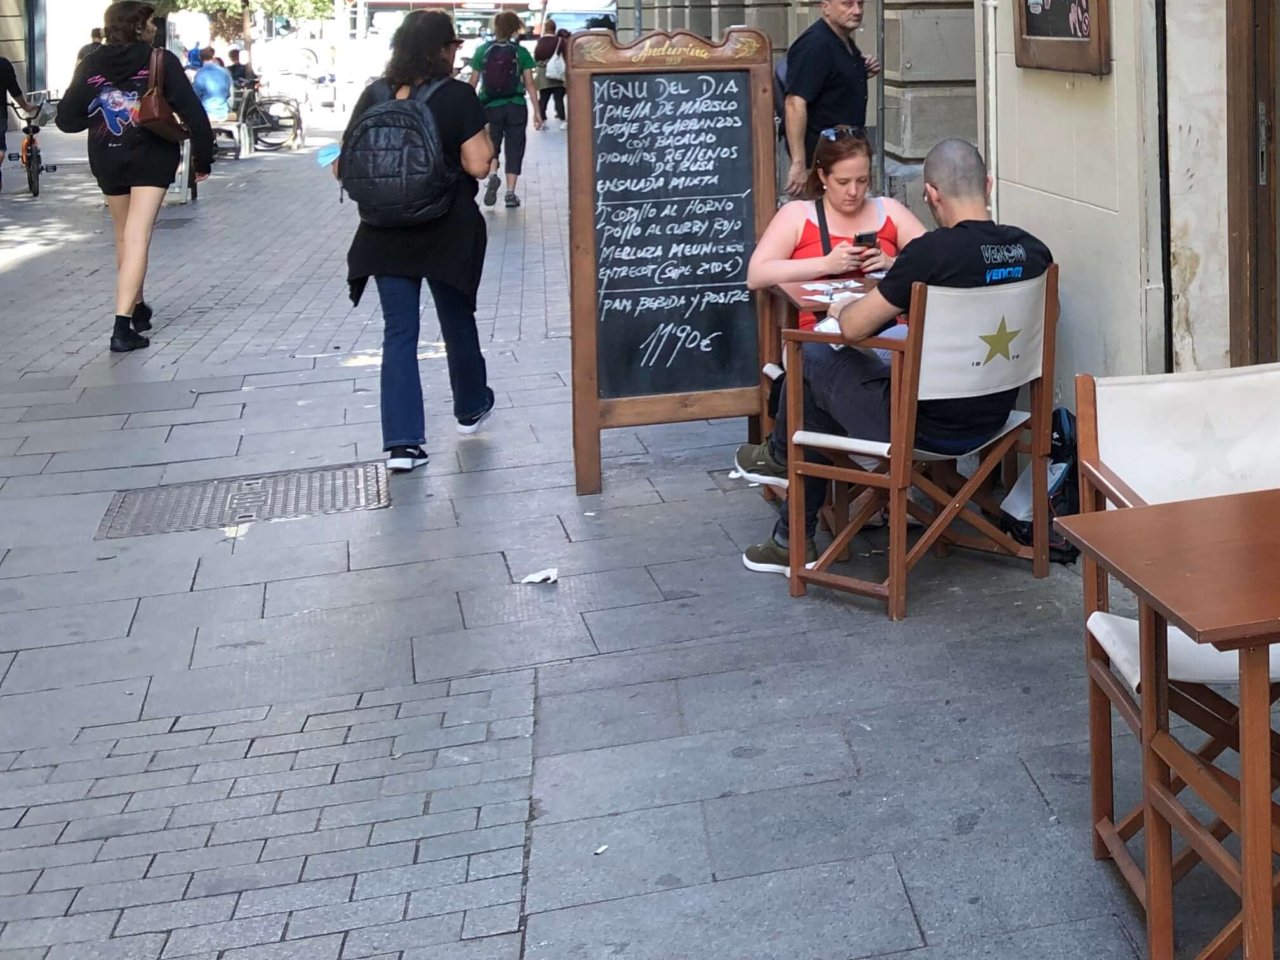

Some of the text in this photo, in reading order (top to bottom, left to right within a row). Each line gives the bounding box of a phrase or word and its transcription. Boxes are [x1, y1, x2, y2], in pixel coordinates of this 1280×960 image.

[593, 75, 739, 103] MENU DEL DIA
[602, 100, 652, 125] PAELLA
[651, 101, 675, 119] DE
[676, 98, 738, 117] MARISCO
[598, 116, 743, 143] POTAJE DE GARBANZOS
[626, 132, 717, 149] CON BACALAO
[663, 145, 739, 163] RELLENOS
[651, 161, 675, 177] DE
[596, 174, 720, 192] ENSALADA MIXTA
[660, 204, 678, 217] AL
[683, 198, 734, 218] HORNO
[600, 217, 743, 248] POLLO AL CURRY ROJO
[599, 245, 663, 264] MERLUZA
[980, 243, 1027, 265] VENOM
[634, 295, 687, 317] BEBIDA
[700, 289, 750, 312] POSTRE
